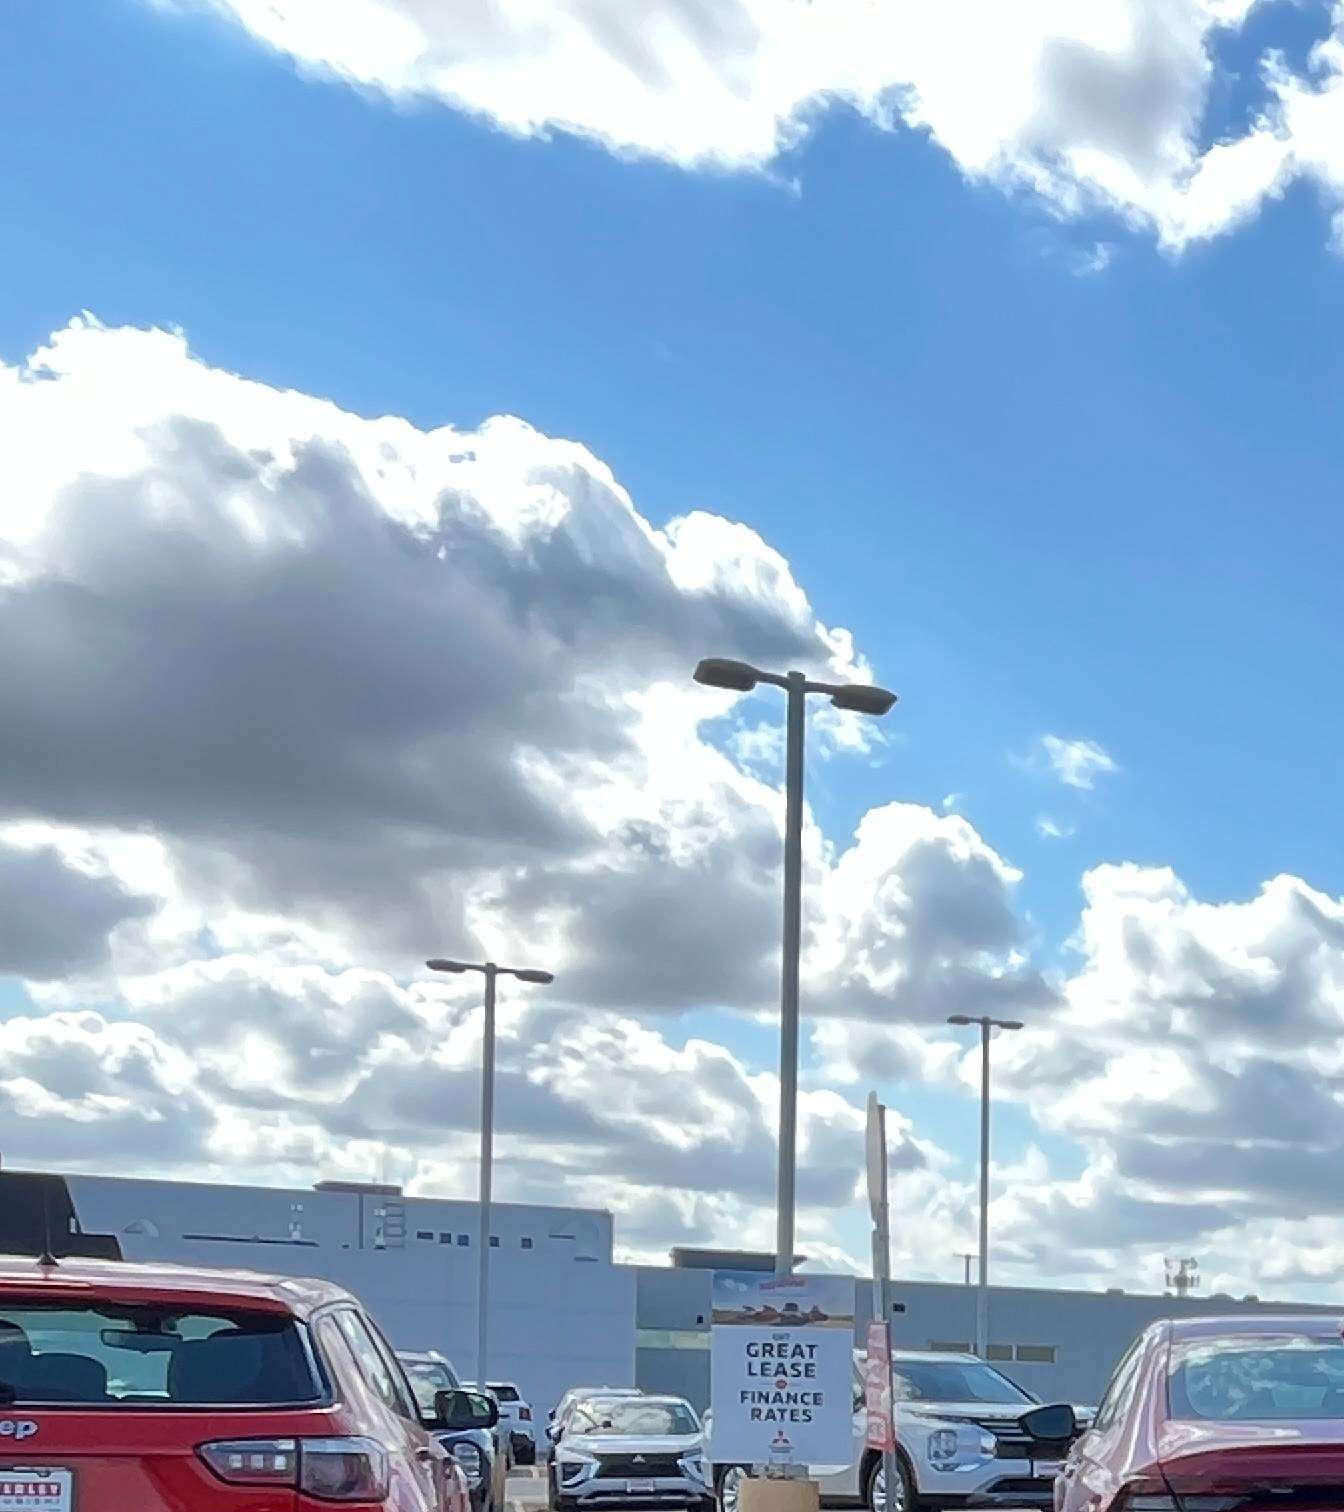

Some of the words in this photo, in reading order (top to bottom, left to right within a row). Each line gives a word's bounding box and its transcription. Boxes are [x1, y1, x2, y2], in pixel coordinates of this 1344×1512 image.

[746, 1342, 819, 1360] GREAT
[747, 1362, 817, 1379] LEASE
[740, 1390, 824, 1406] FINANCE
[751, 1408, 813, 1423] RATES
